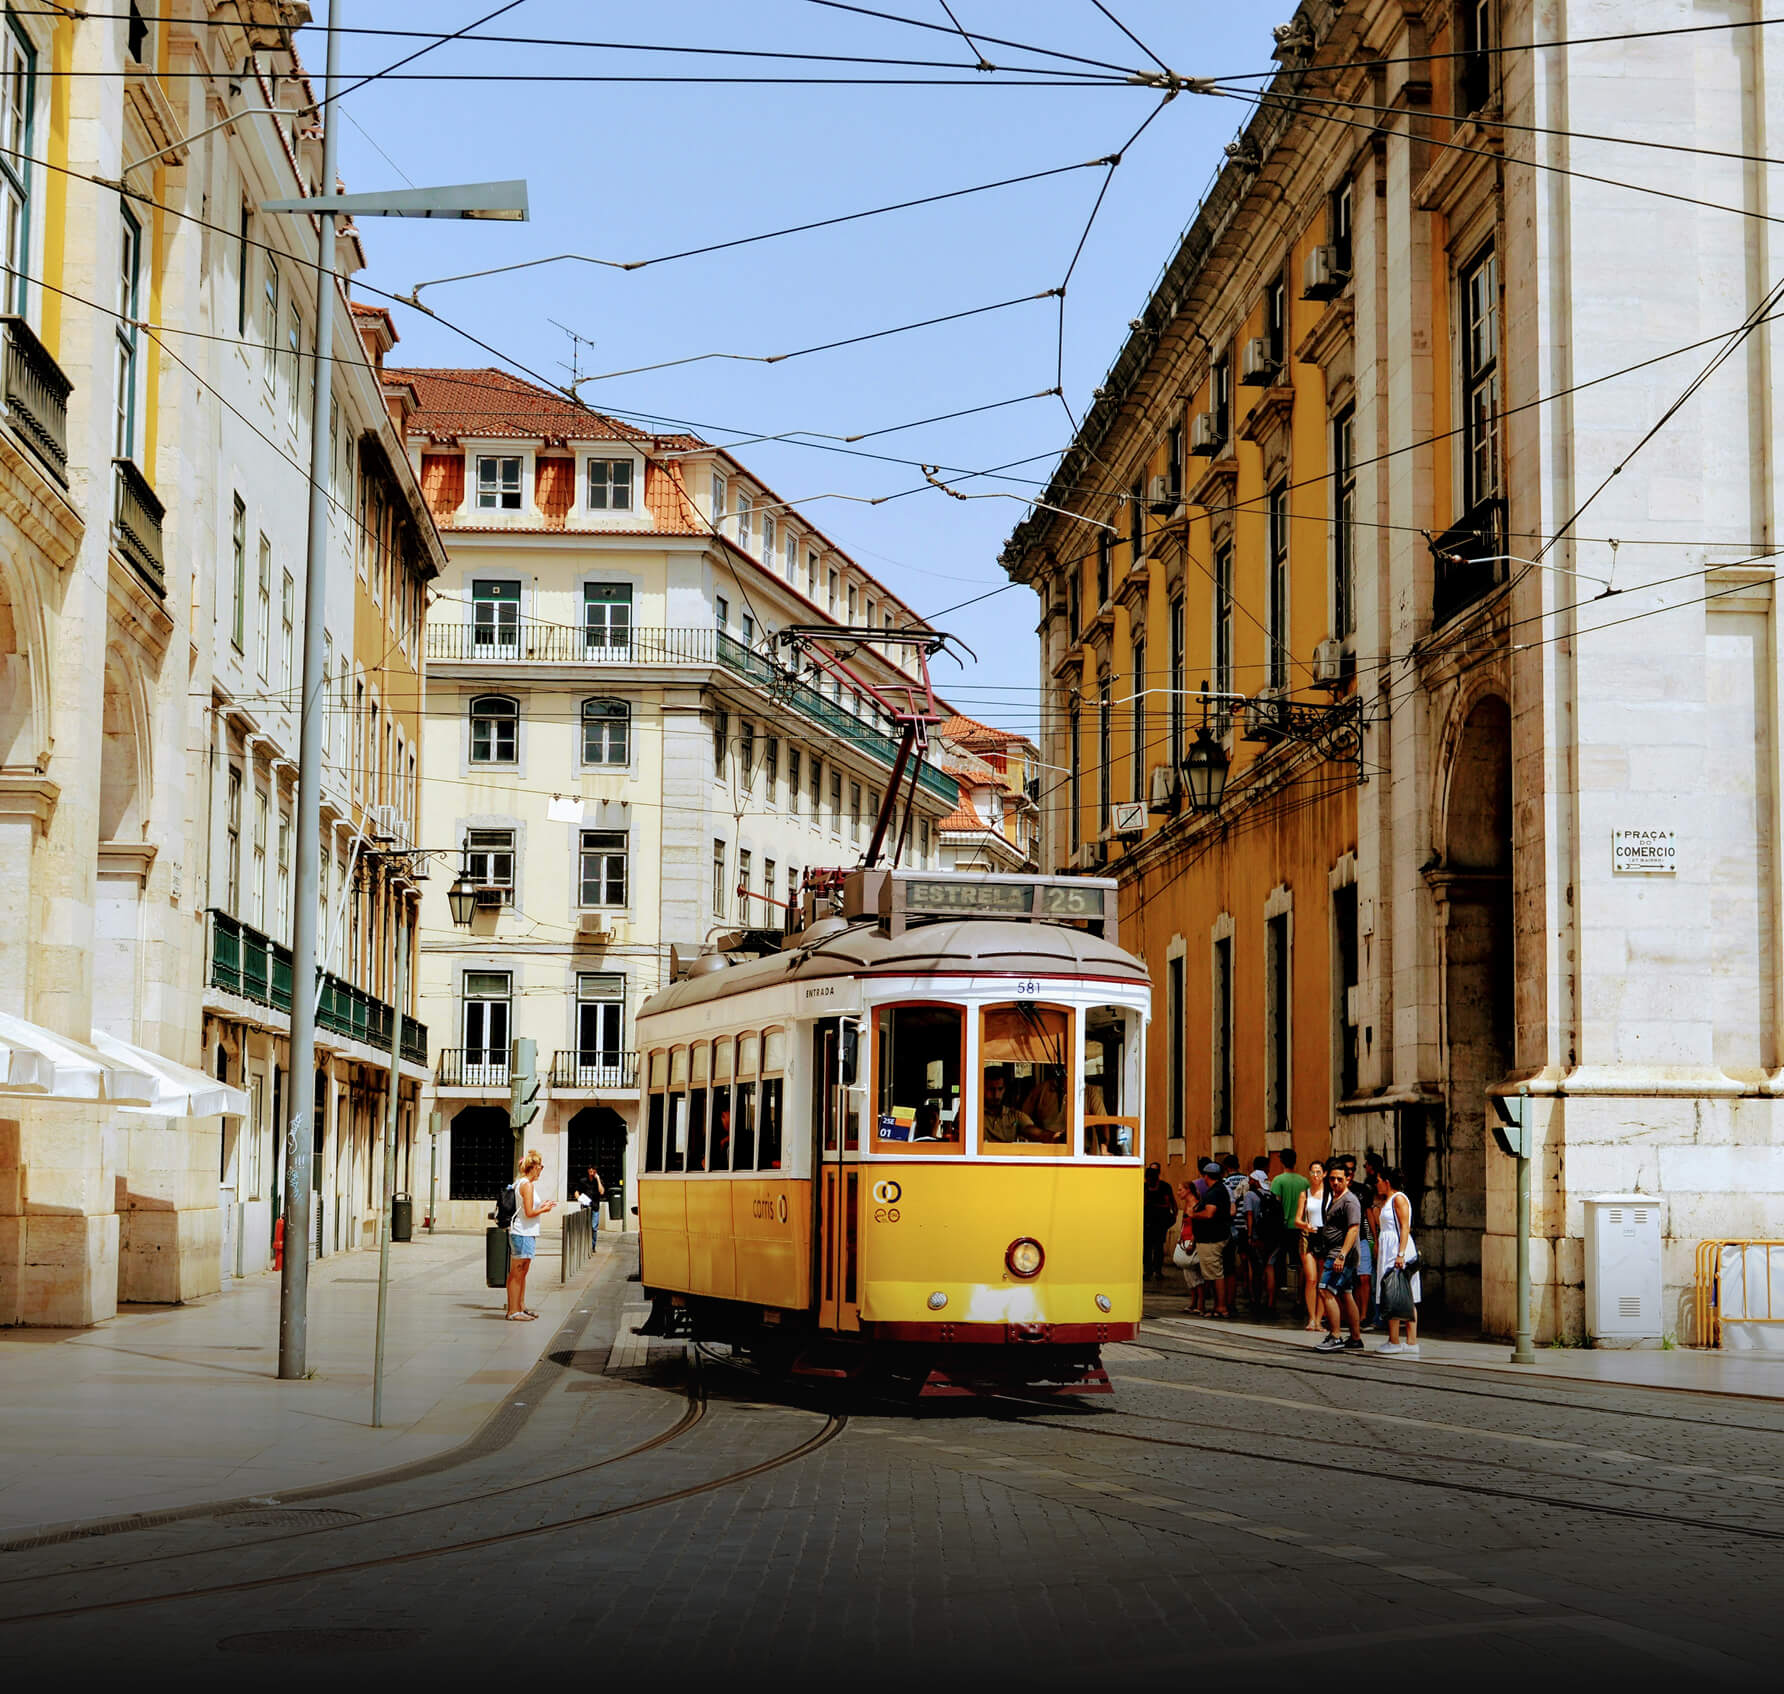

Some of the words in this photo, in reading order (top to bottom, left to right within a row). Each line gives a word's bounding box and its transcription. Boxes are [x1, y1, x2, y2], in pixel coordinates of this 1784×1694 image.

[1624, 830, 1667, 841] PRAÇA
[1616, 846, 1676, 857] COMERCIO
[913, 883, 1024, 906] ESTRELA
[1048, 888, 1086, 912] 25
[805, 986, 835, 999] ENTRADA
[1017, 981, 1041, 994] 581
[879, 1127, 892, 1138] 01
